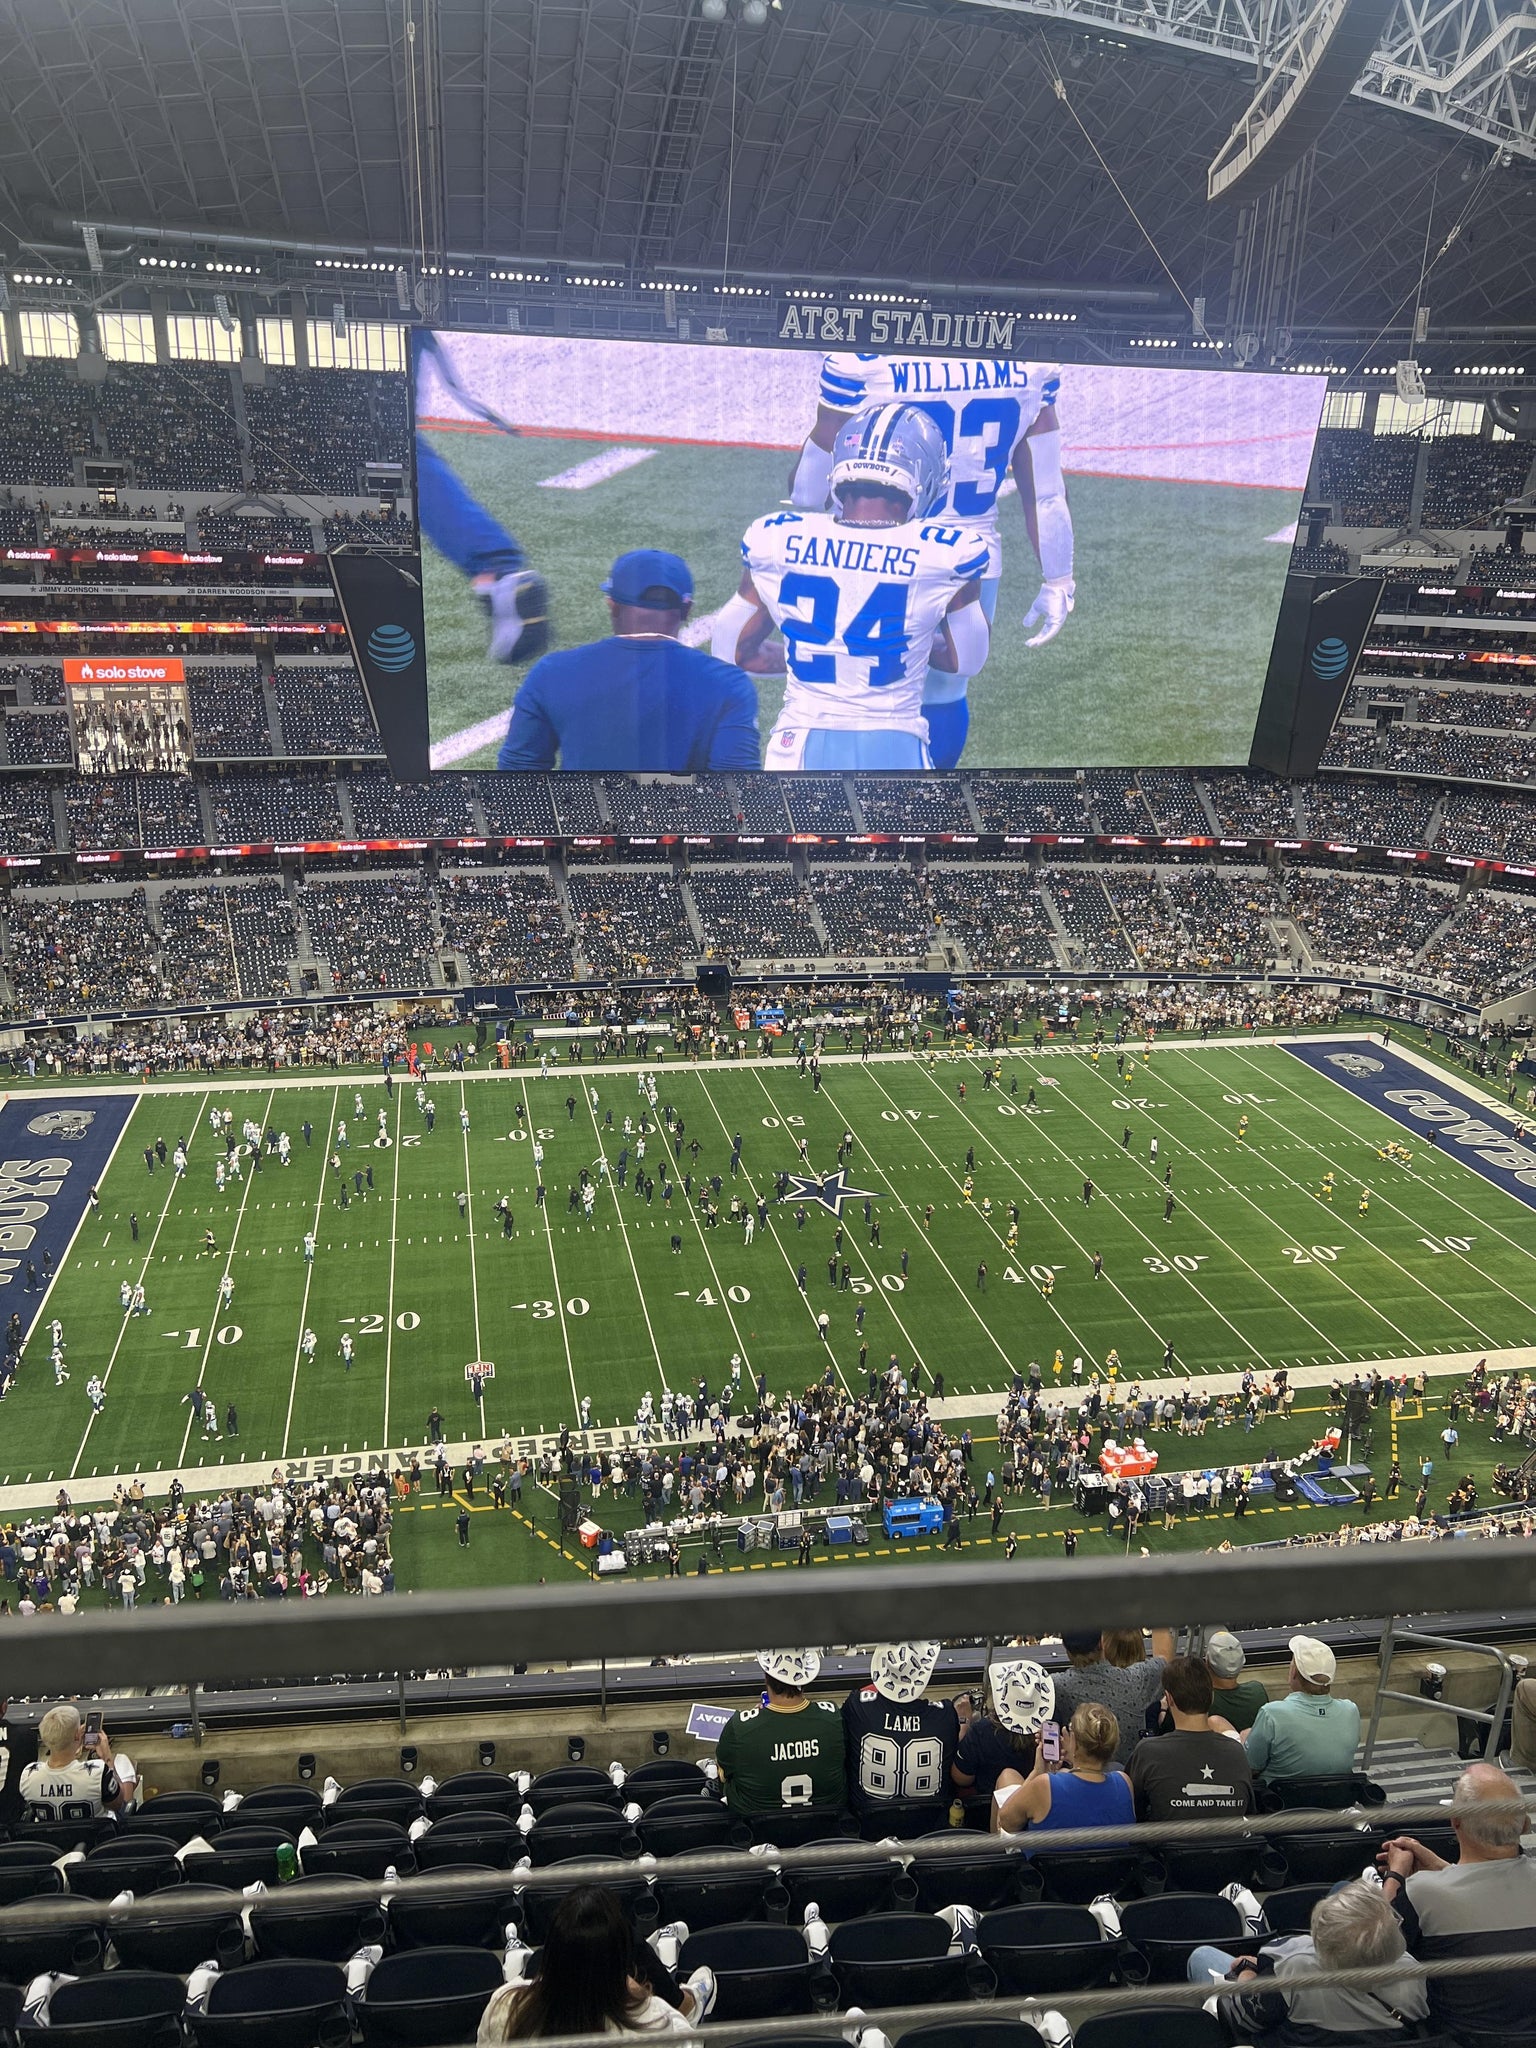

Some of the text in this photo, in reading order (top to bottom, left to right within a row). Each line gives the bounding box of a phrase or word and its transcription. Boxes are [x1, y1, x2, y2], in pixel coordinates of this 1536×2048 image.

[779, 304, 1016, 350] AT&T STADIUM
[888, 360, 1028, 394] WILLIAMS
[853, 461, 890, 473] COWBOYS
[784, 534, 920, 577] SANDERS
[777, 572, 912, 687] 24
[96, 666, 166, 678] solo stove
[740, 1708, 759, 1722] 8
[884, 1713, 921, 1732] LAMB
[770, 1738, 820, 1761] JACOBS
[859, 1732, 943, 1800] 88
[40, 1784, 73, 1797] LAMB
[1170, 1799, 1244, 1807] COME AND TAKE IT
